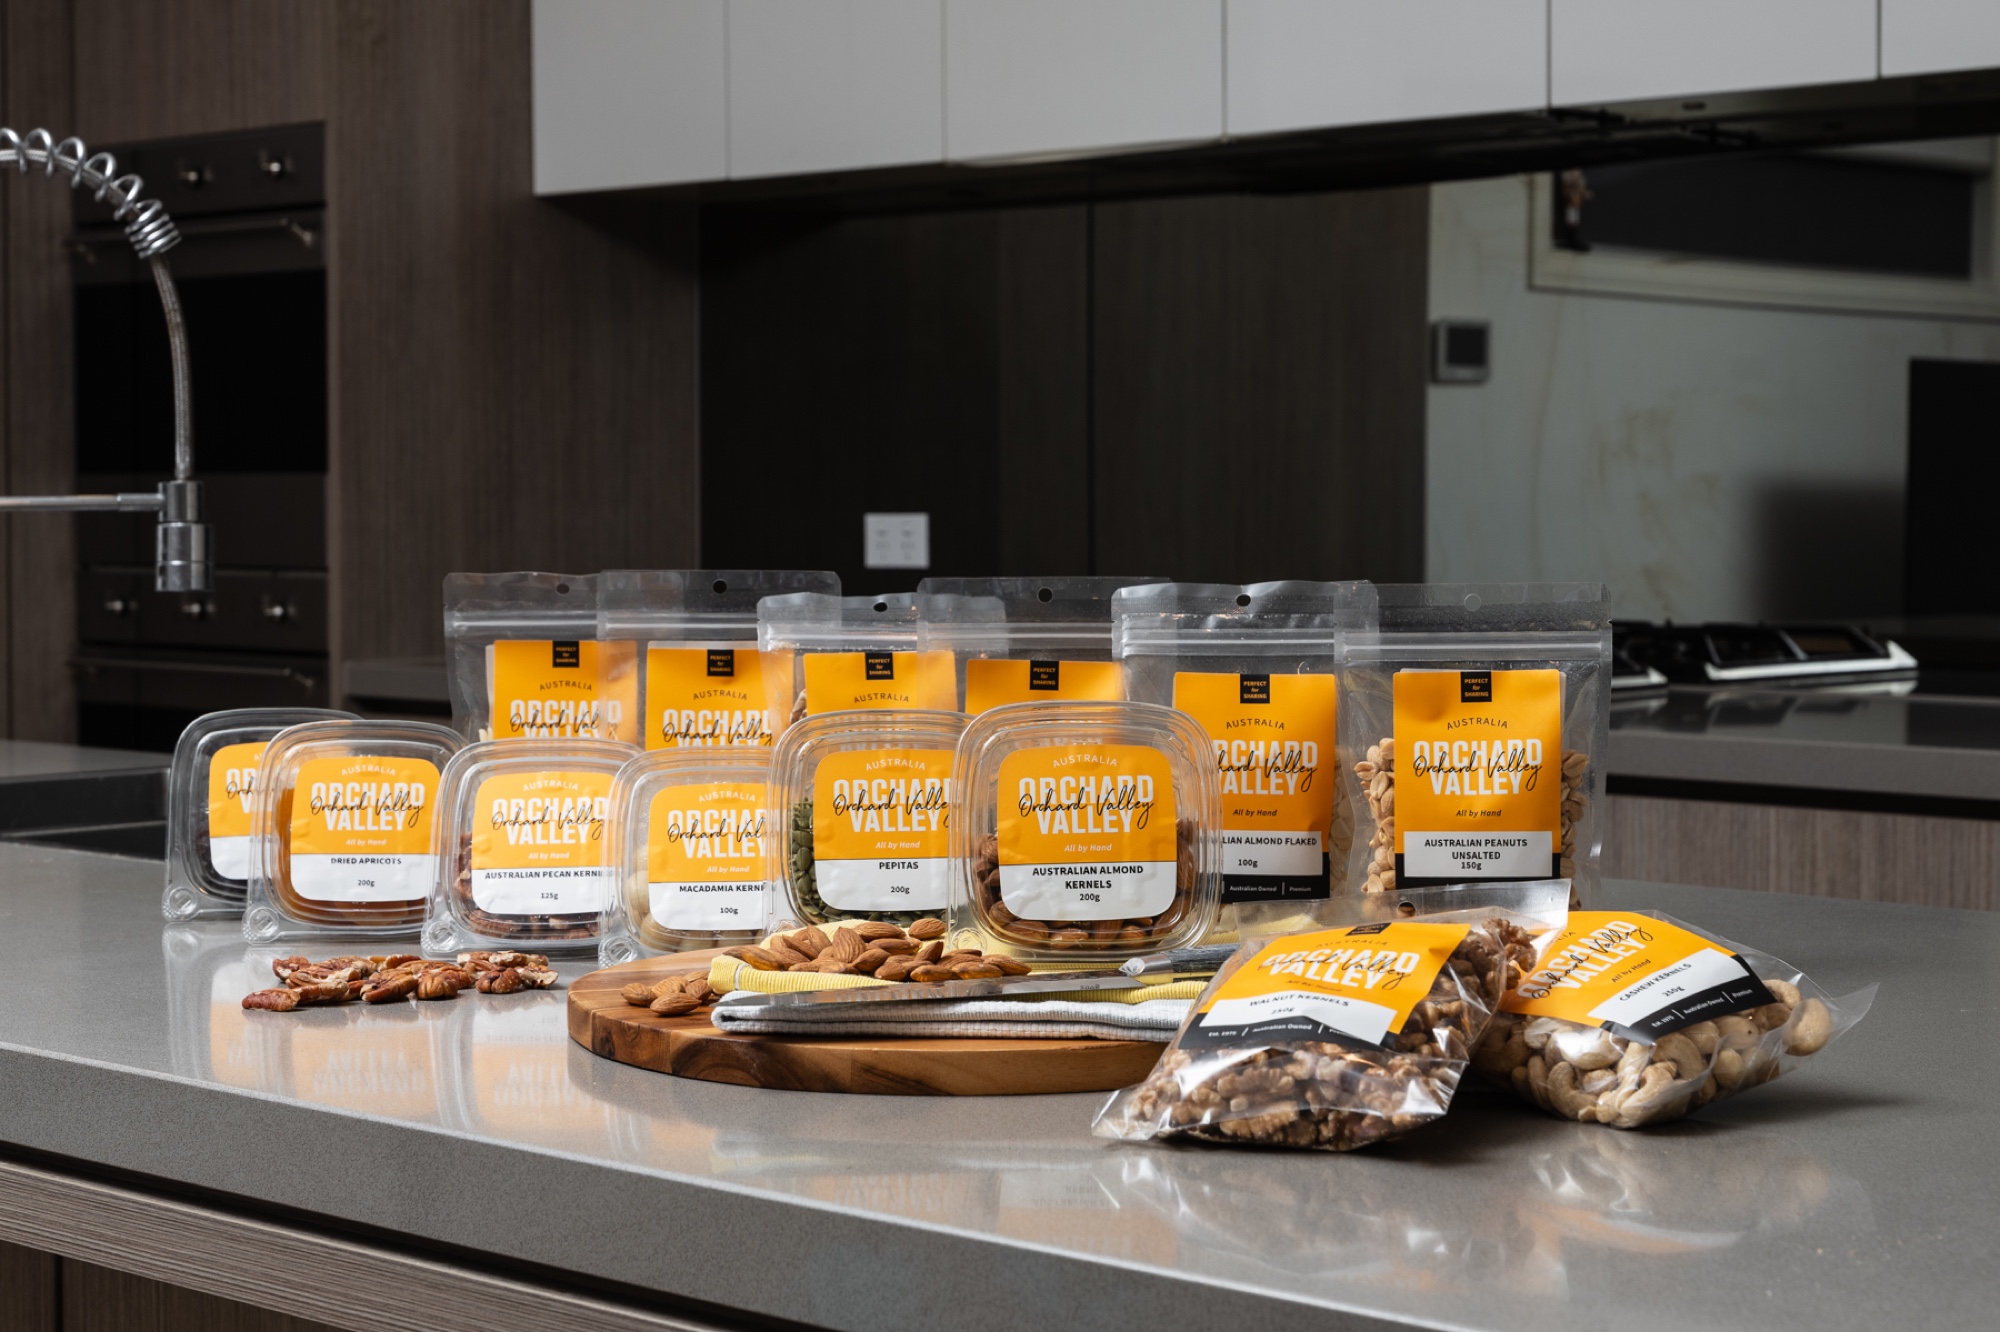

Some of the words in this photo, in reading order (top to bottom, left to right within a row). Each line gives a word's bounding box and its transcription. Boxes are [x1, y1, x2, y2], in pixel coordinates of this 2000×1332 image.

[540, 680, 592, 691] AUSTRALIA
[693, 690, 747, 700] AUSTRALIA
[854, 693, 909, 703] AUSTRALIA
[510, 709, 567, 733] Orchard
[1226, 719, 1285, 730] AUSTRALIA
[1447, 717, 1508, 730] AUSTRALIA
[662, 719, 721, 743] Orchard
[1212, 740, 1318, 768] RCHARD
[1413, 738, 1542, 768] ORCHARD
[866, 758, 926, 771] AUSTRALIA
[1053, 754, 1117, 768] AUSTRALIA
[342, 764, 396, 776] AUSTRALIA
[1218, 750, 1256, 773] hard
[1265, 750, 1318, 792] Valley
[1413, 750, 1478, 778] Orchard
[1488, 748, 1543, 791] Valley
[523, 780, 579, 791] AUSTRALIA
[1221, 768, 1299, 795] ALLEY
[1429, 768, 1523, 796] VALLEY
[311, 782, 425, 807] ORCHARD
[699, 790, 755, 802] AUSTRALIA
[1019, 775, 1154, 805] ORCHARD
[833, 788, 897, 816] Orchard
[1018, 786, 1087, 817] Orchard
[1097, 785, 1154, 829] Valley
[310, 791, 367, 815] Orchard
[376, 791, 424, 828] Valley
[1245, 809, 1254, 817] by
[1469, 810, 1478, 818] by
[324, 807, 407, 831] VALLEY
[491, 806, 550, 830] Orchard
[850, 805, 940, 832] VALLEY
[1037, 805, 1133, 835] VALLEY
[505, 820, 590, 846] VALLEY
[667, 818, 728, 843] Orchard
[357, 839, 365, 847] by
[888, 841, 897, 850] by
[1244, 837, 1282, 845] ALMOND
[1285, 837, 1317, 845] FLAKED
[1424, 839, 1482, 847] AUSTRALIAN
[1484, 839, 1528, 847] PEANUTS
[1064, 844, 1076, 852] All
[1078, 844, 1087, 853] by
[1090, 843, 1112, 851] Hand
[540, 852, 549, 860] by
[1452, 851, 1501, 859] UNSALTED
[719, 866, 728, 874] by
[1238, 859, 1258, 868] 100g
[1461, 862, 1482, 870] 150g
[485, 871, 540, 879] AUSTRALIAN
[1032, 867, 1097, 876] AUSTRALIAN
[1100, 866, 1143, 874] ALMOND
[679, 885, 734, 893] MACADAMIA
[891, 886, 910, 894] 200g
[1065, 880, 1112, 889] KERNELS
[1079, 893, 1100, 902] 200g
[720, 907, 738, 915] 100g
[1589, 926, 1654, 953] Valley
[1261, 948, 1421, 973] ORCHARD
[1517, 920, 1638, 999] ORCHARD
[1552, 934, 1647, 989] VALLEY
[1269, 962, 1387, 990] VALLEY
[1341, 955, 1411, 990] Valley
[1612, 974, 1621, 983] All
[1623, 969, 1632, 978] by
[1632, 958, 1651, 971] Hand
[1619, 979, 1655, 1001] CASHEW
[1655, 963, 1692, 983] KERNELS
[1662, 985, 1685, 997] 250g
[1249, 993, 1295, 1006] WALNUT
[1297, 993, 1350, 1007] KERNELS
